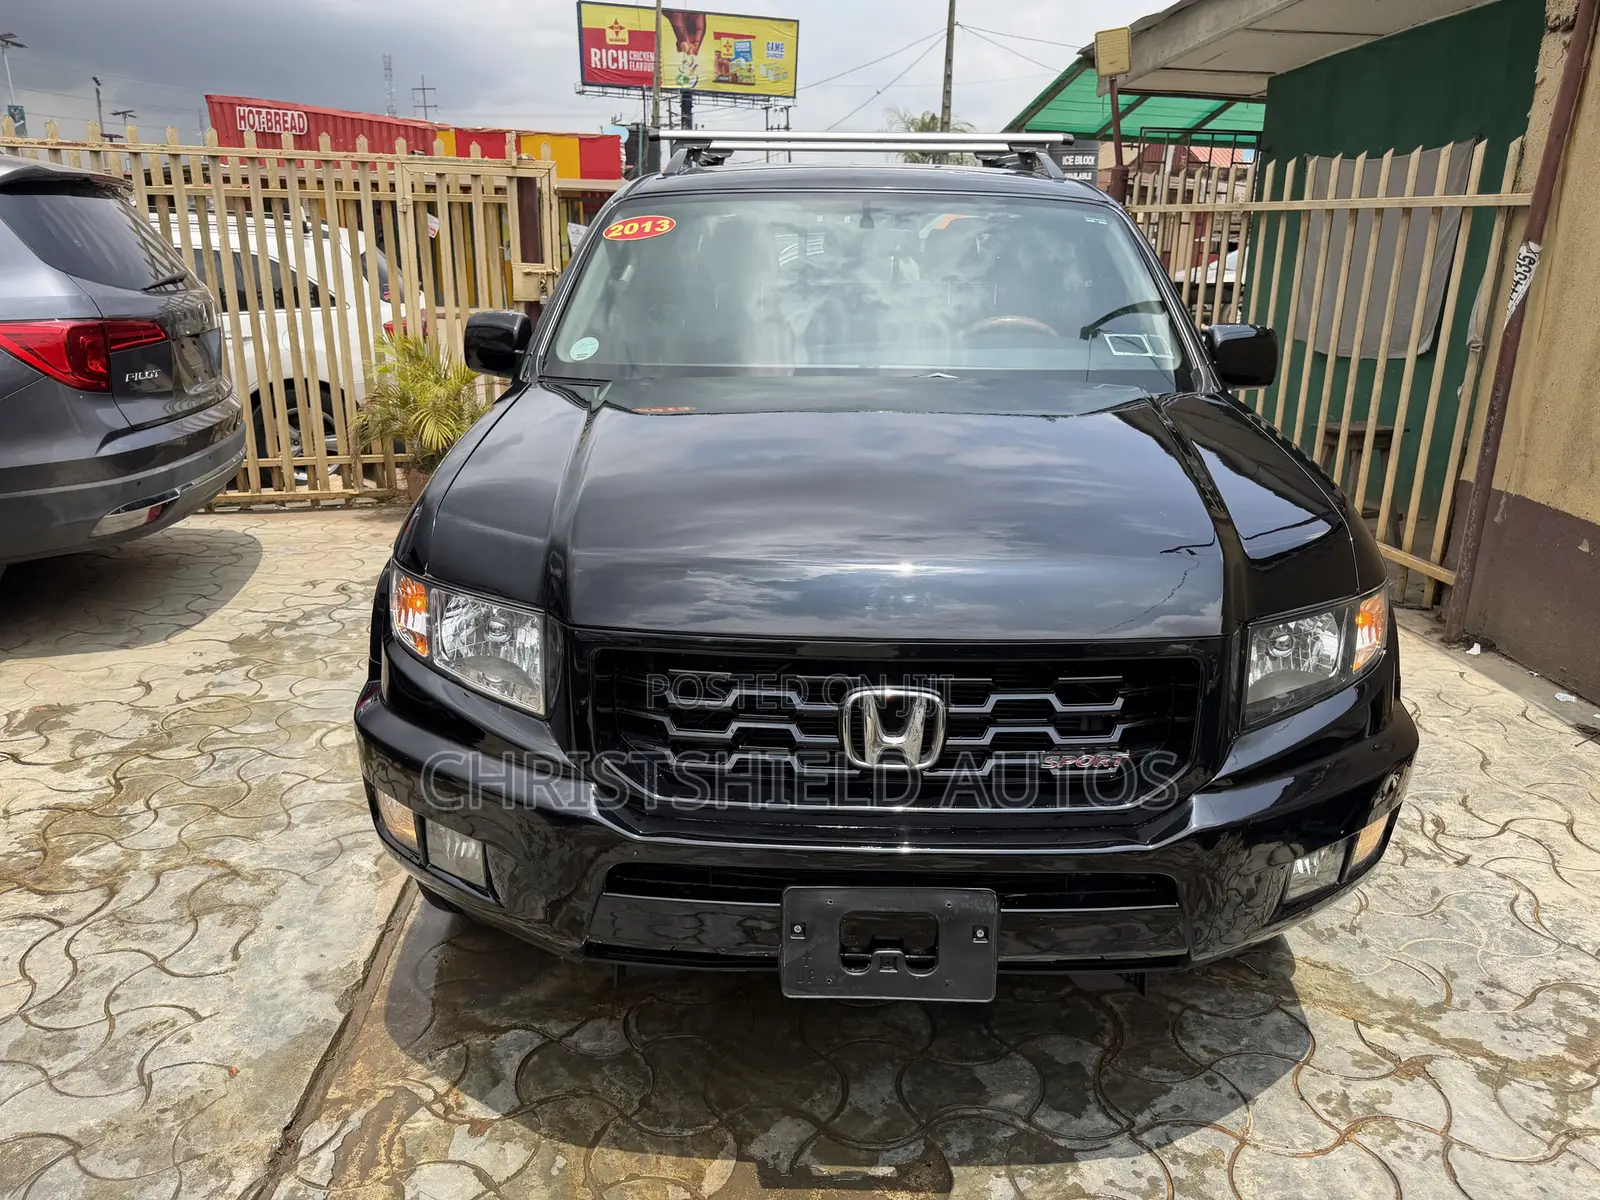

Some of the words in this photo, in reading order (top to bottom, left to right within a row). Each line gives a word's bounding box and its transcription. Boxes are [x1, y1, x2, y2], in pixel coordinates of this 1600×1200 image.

[590, 47, 629, 70] RICH
[236, 107, 263, 131] HOT
[264, 109, 307, 134] BREAD
[1062, 155, 1074, 165] ICE
[1074, 155, 1095, 165] BLOCK
[607, 219, 671, 238] 2013
[125, 369, 161, 382] PILOT
[1041, 752, 1130, 769] SPORT
